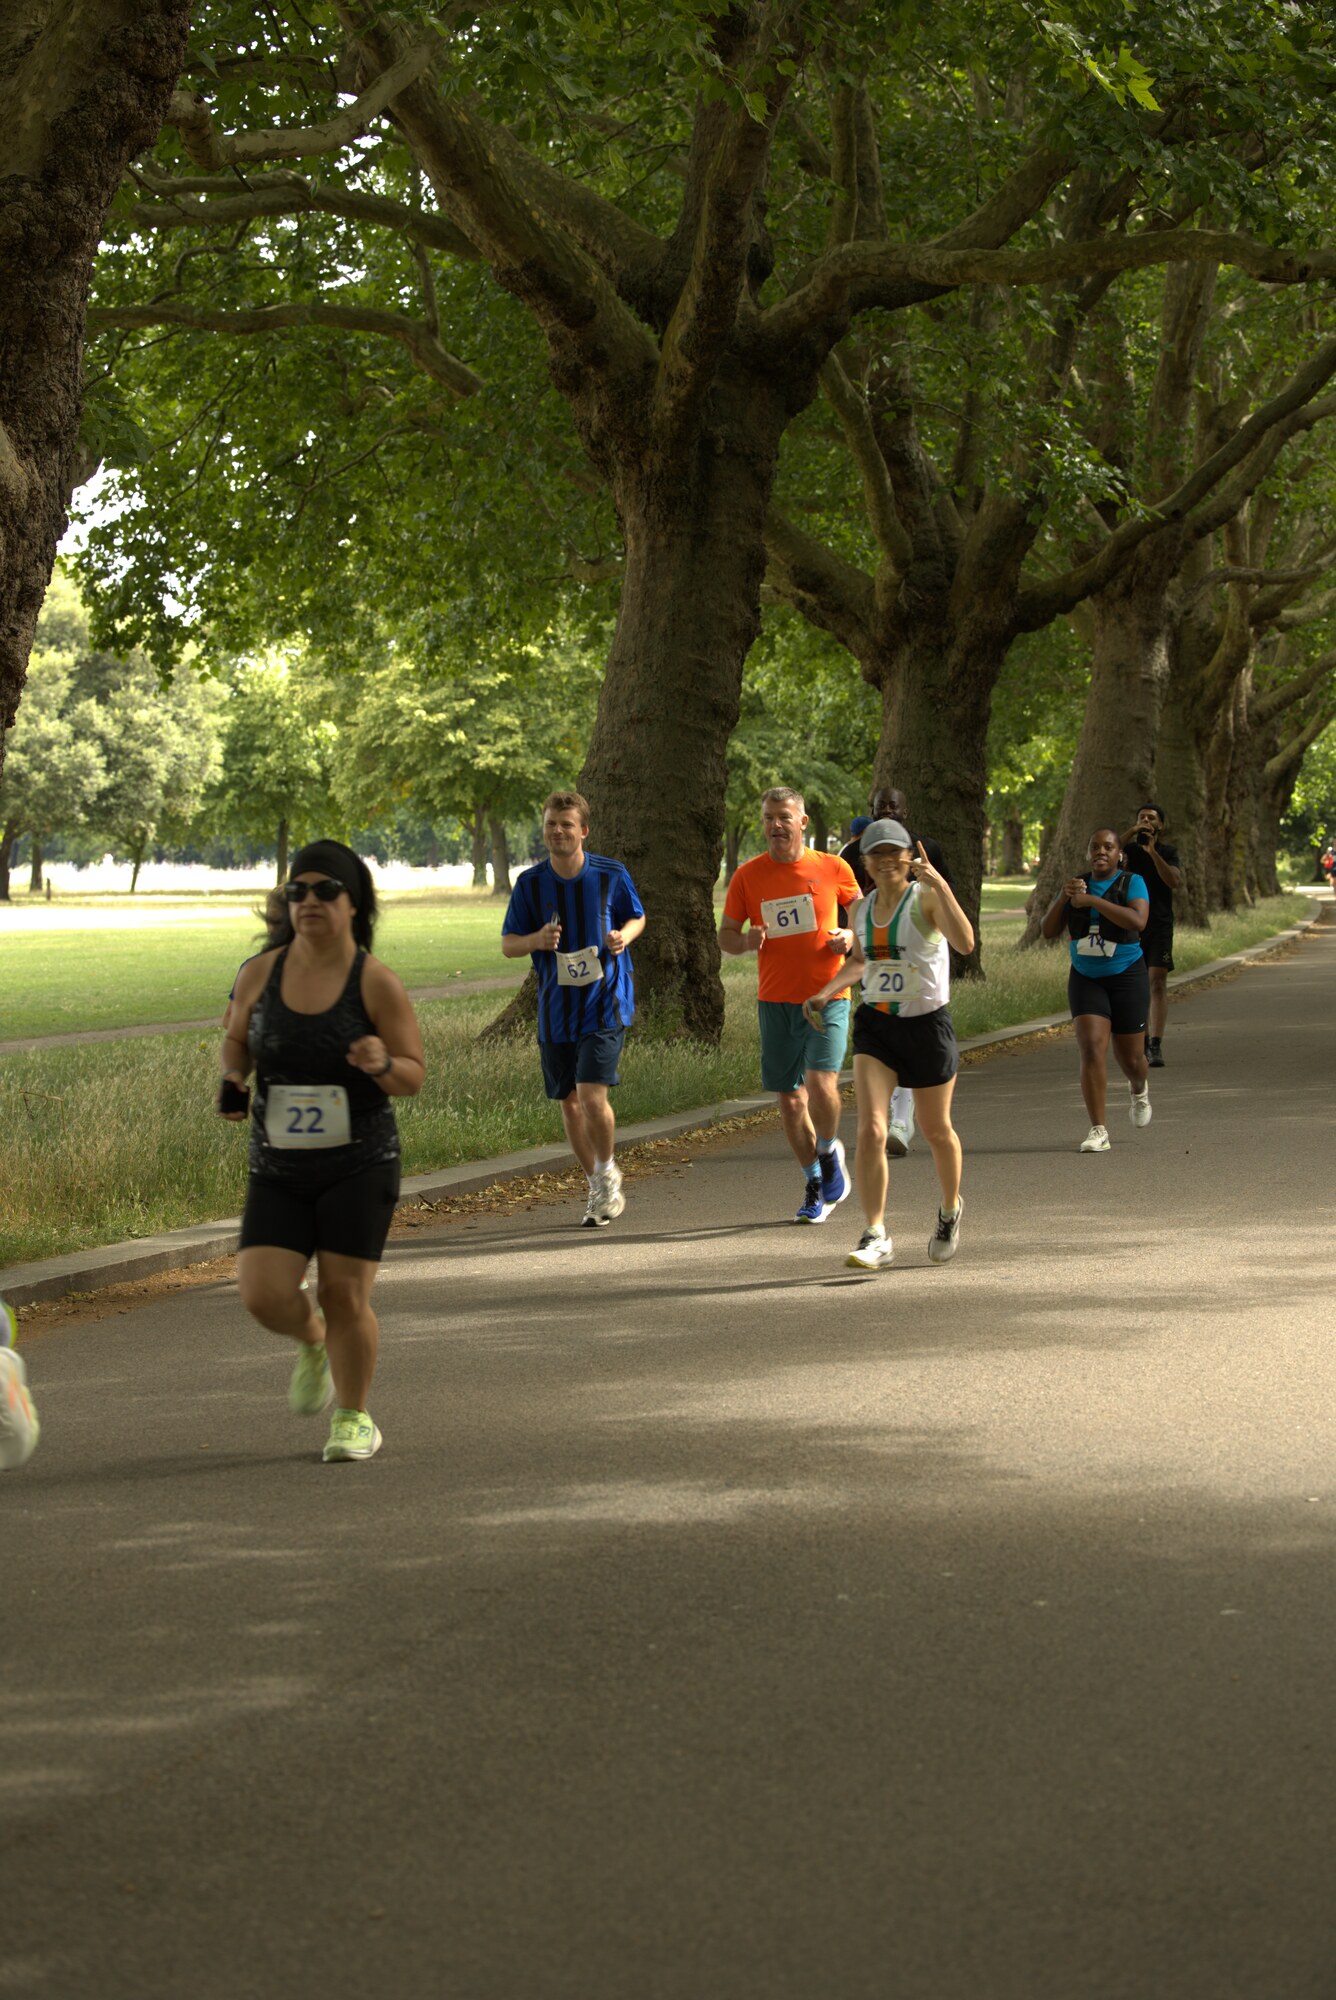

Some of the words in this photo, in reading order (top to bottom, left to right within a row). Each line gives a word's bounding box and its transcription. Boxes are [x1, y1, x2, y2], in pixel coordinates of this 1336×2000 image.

[777, 908, 799, 927] 61
[567, 960, 590, 978] 62
[879, 973, 904, 992] 20
[286, 1106, 325, 1133] 22
